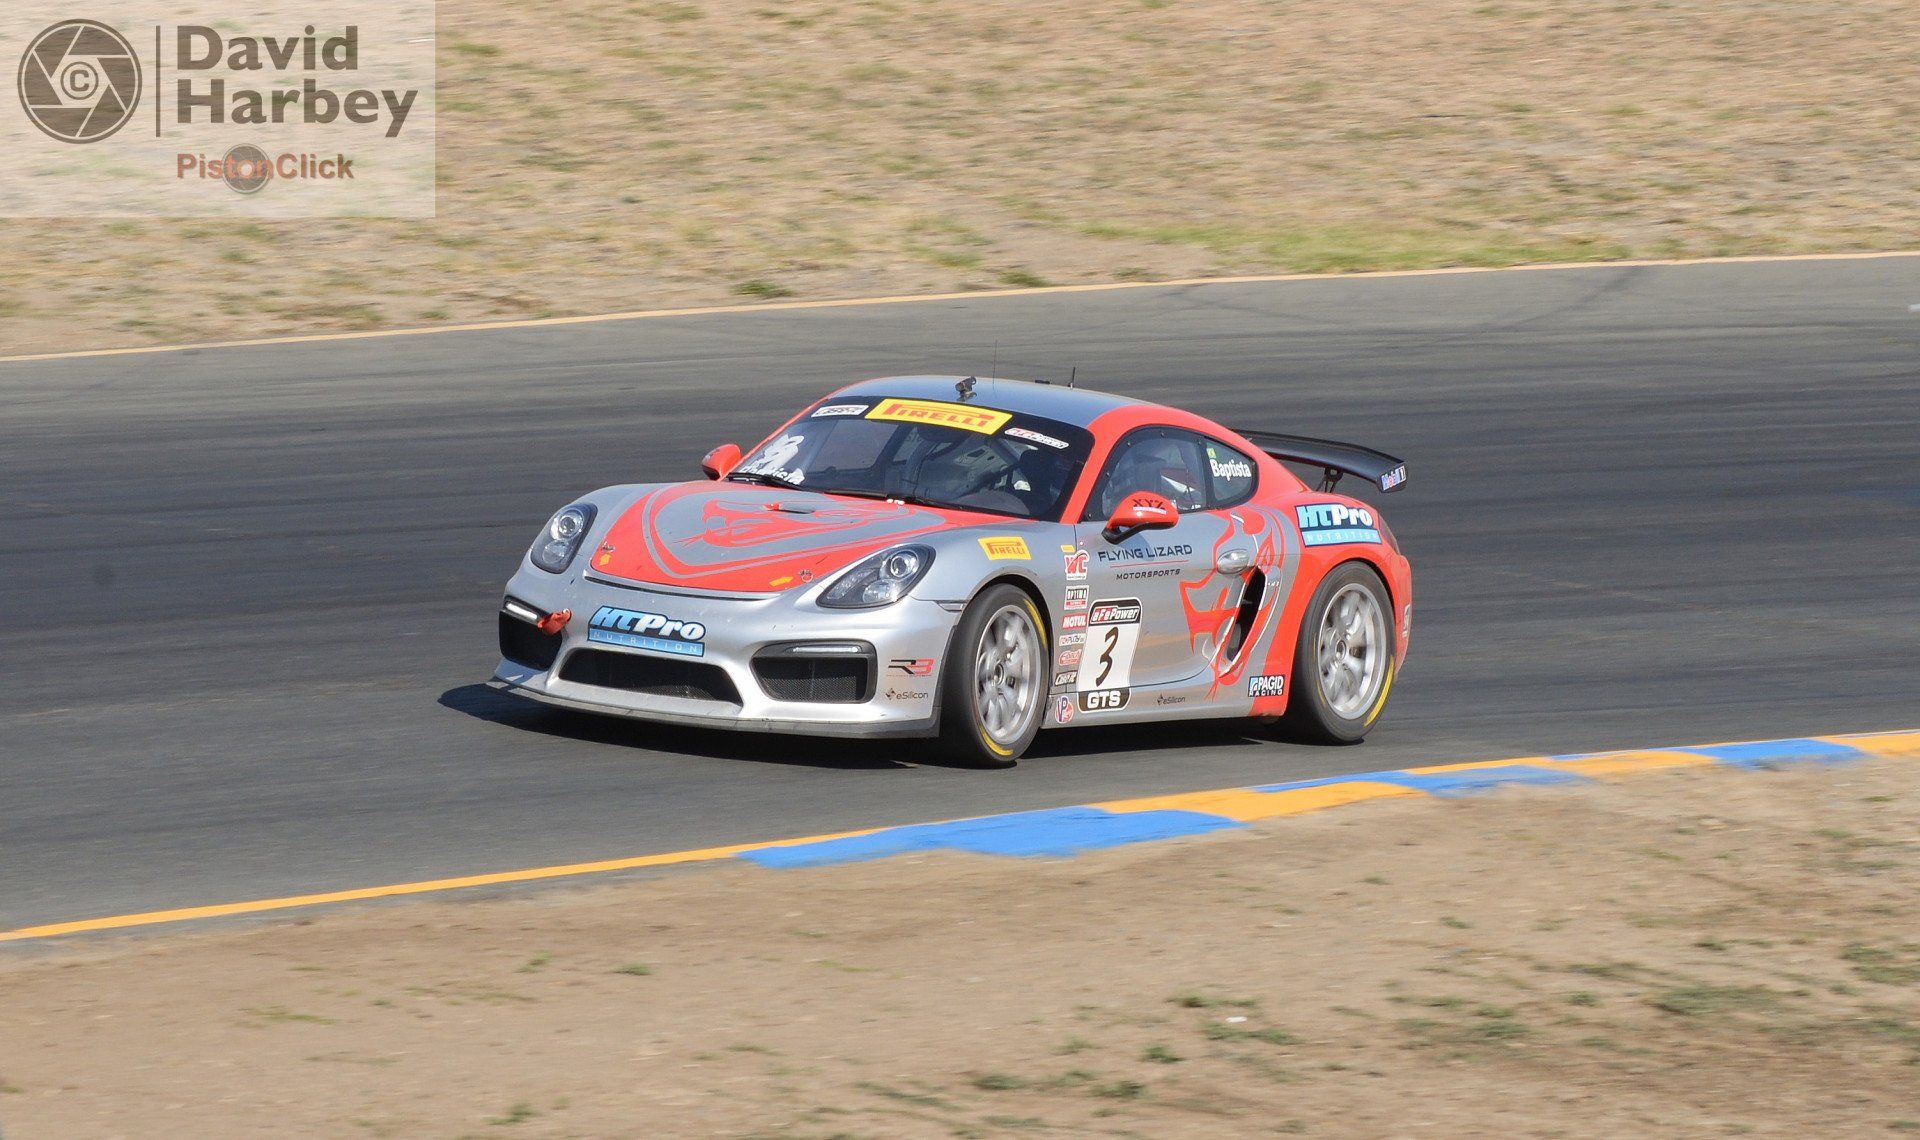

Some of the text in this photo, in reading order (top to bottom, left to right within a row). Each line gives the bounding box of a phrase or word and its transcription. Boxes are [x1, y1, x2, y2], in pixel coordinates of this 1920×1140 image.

[885, 402, 996, 430] PIRELLI
[1209, 458, 1252, 482] Baptista
[1298, 504, 1373, 528] HTPro
[986, 541, 1025, 556] PIRELLI
[1098, 544, 1193, 562] FLYING LIZARD
[1116, 568, 1181, 580] MOTORSPORTS
[590, 607, 705, 641] HTPro
[1063, 615, 1087, 628] MOTUL
[592, 630, 699, 654] NUTRITION
[1095, 626, 1119, 687] 3
[1257, 676, 1284, 691] PAGID
[896, 691, 929, 700] eSilicon
[1087, 691, 1121, 709] GTS
[1249, 688, 1283, 698] RACING
